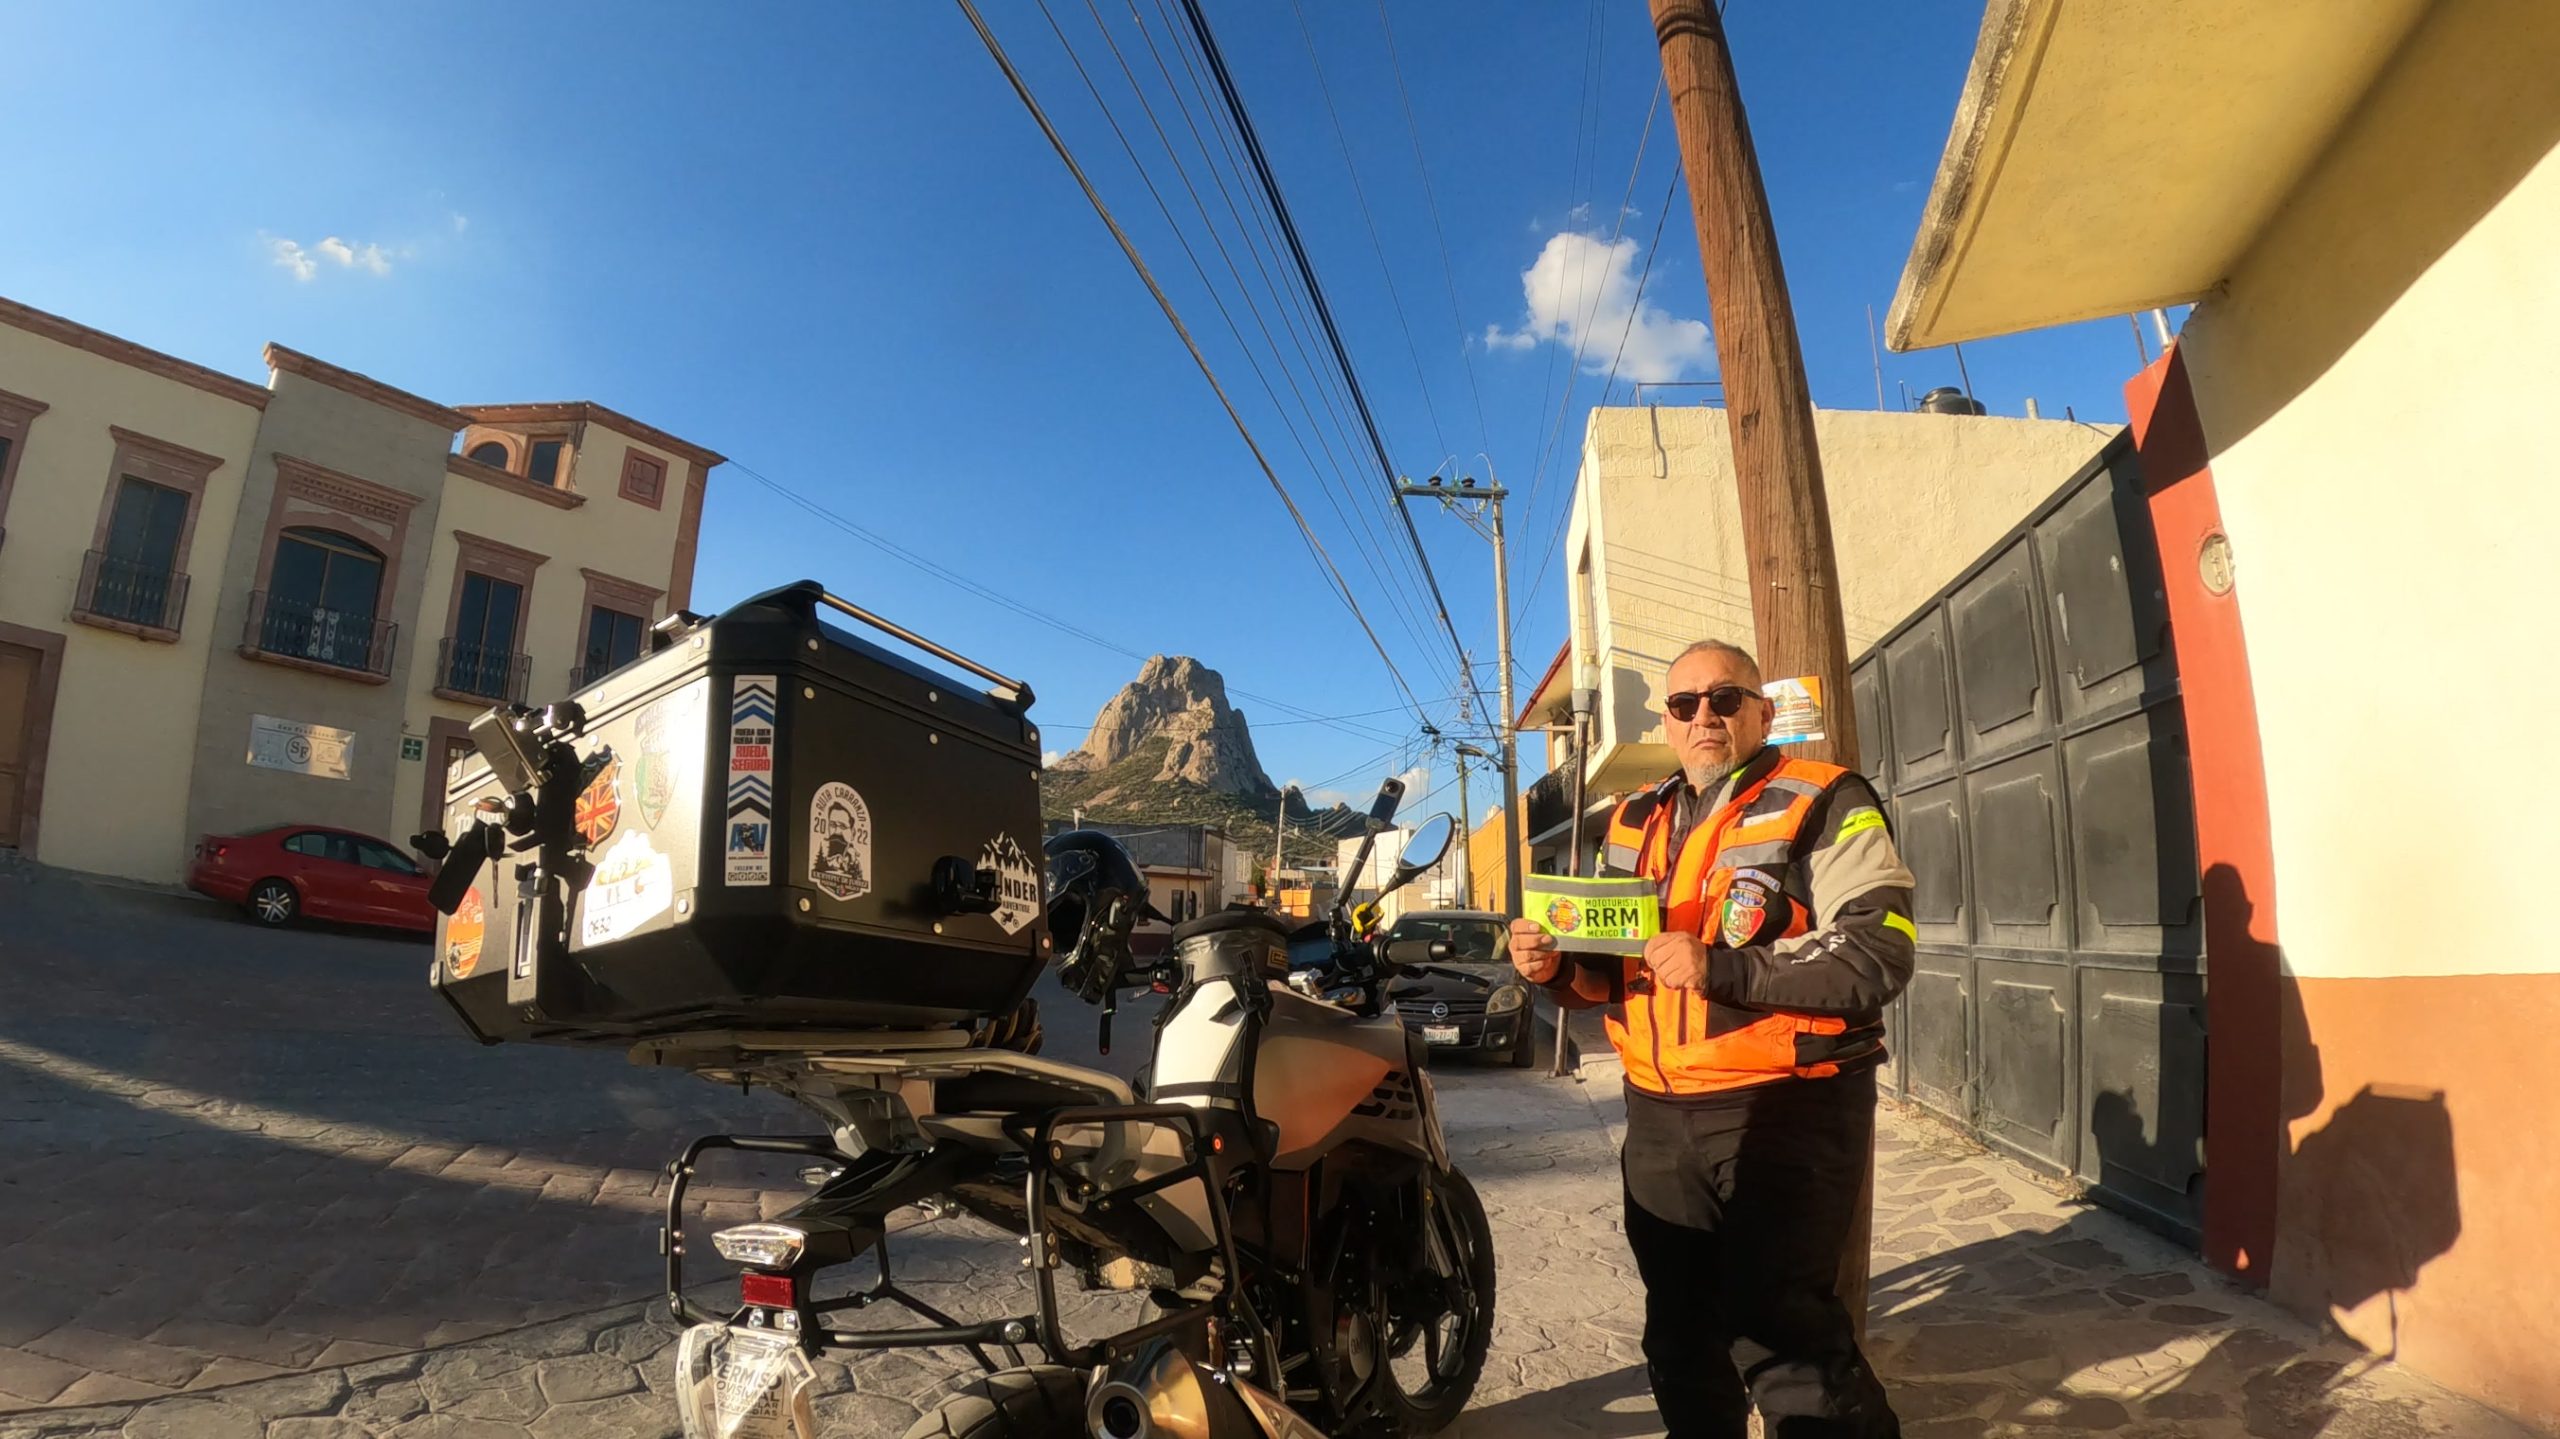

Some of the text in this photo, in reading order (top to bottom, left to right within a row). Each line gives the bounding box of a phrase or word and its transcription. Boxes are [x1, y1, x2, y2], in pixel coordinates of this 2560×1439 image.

[290, 741, 309, 758] SF
[736, 745, 768, 758] RUEDA
[731, 759, 770, 771] SEGURO
[815, 789, 833, 812] RUTA
[814, 817, 826, 835] 20
[857, 827, 869, 846] 22
[1585, 898, 1639, 907] MOTOTURISTA
[1585, 908, 1639, 927] RRM
